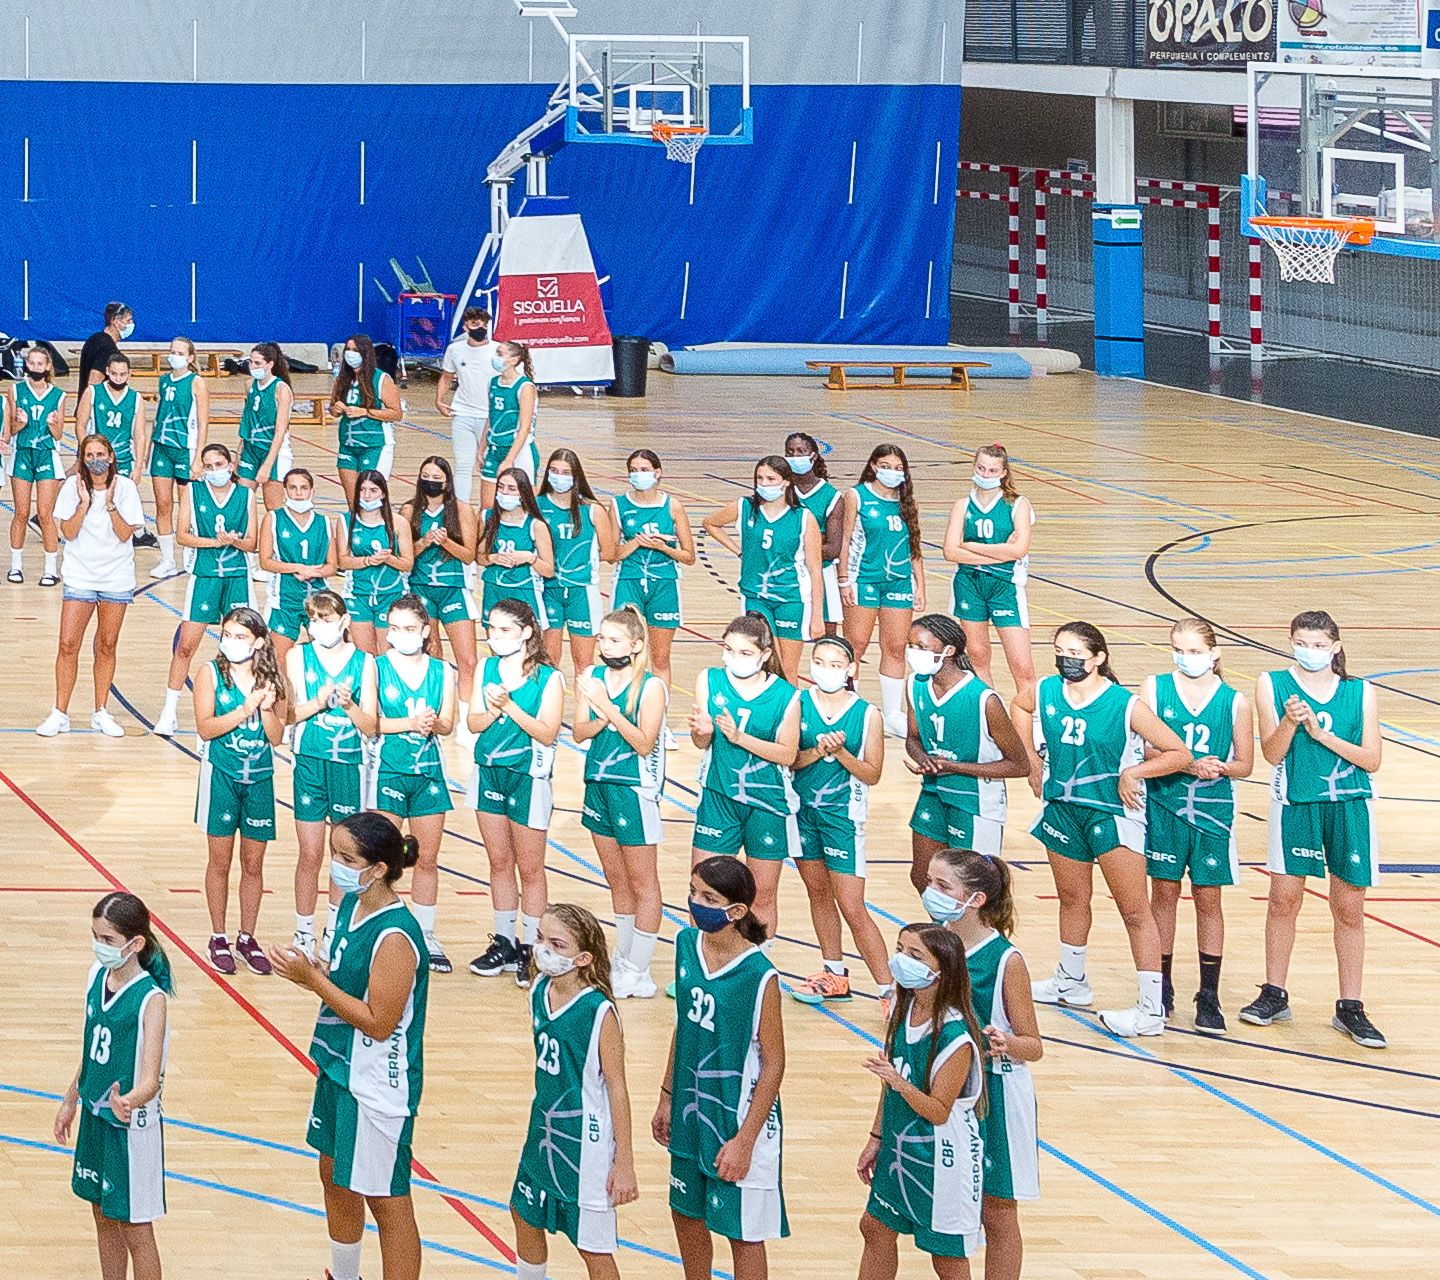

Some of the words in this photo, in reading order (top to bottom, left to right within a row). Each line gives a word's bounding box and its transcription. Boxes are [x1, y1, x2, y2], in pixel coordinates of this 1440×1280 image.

[1207, 52, 1271, 61] COMPLEMENTS
[513, 300, 585, 315] SISQUELLA
[165, 387, 176, 400] 16
[253, 396, 260, 411] 3
[31, 405, 44, 420] 17
[107, 411, 121, 427] 24
[887, 516, 902, 531] 18
[975, 519, 993, 538] 10
[762, 529, 773, 549] 5
[300, 540, 308, 559] 1
[887, 590, 914, 603] CBFC
[566, 620, 591, 629] CBFC
[654, 612, 680, 622] CBFC
[776, 620, 797, 628] CBFC
[736, 708, 751, 733] 7
[1061, 716, 1086, 746] 23
[1183, 723, 1210, 752] 12
[382, 787, 405, 801] CBFC
[333, 804, 356, 814] CBFC
[247, 818, 271, 827] CBFC
[696, 825, 722, 838] CBFC
[1043, 822, 1069, 843] CBFC
[824, 847, 848, 859] CBFC
[1147, 850, 1176, 863] CBFC
[1292, 845, 1323, 860] CBFC
[688, 987, 715, 1032] 32
[90, 1024, 111, 1064] 13
[538, 1032, 560, 1075] 23
[588, 1113, 599, 1143] CBF
[942, 1139, 955, 1167] CBF
